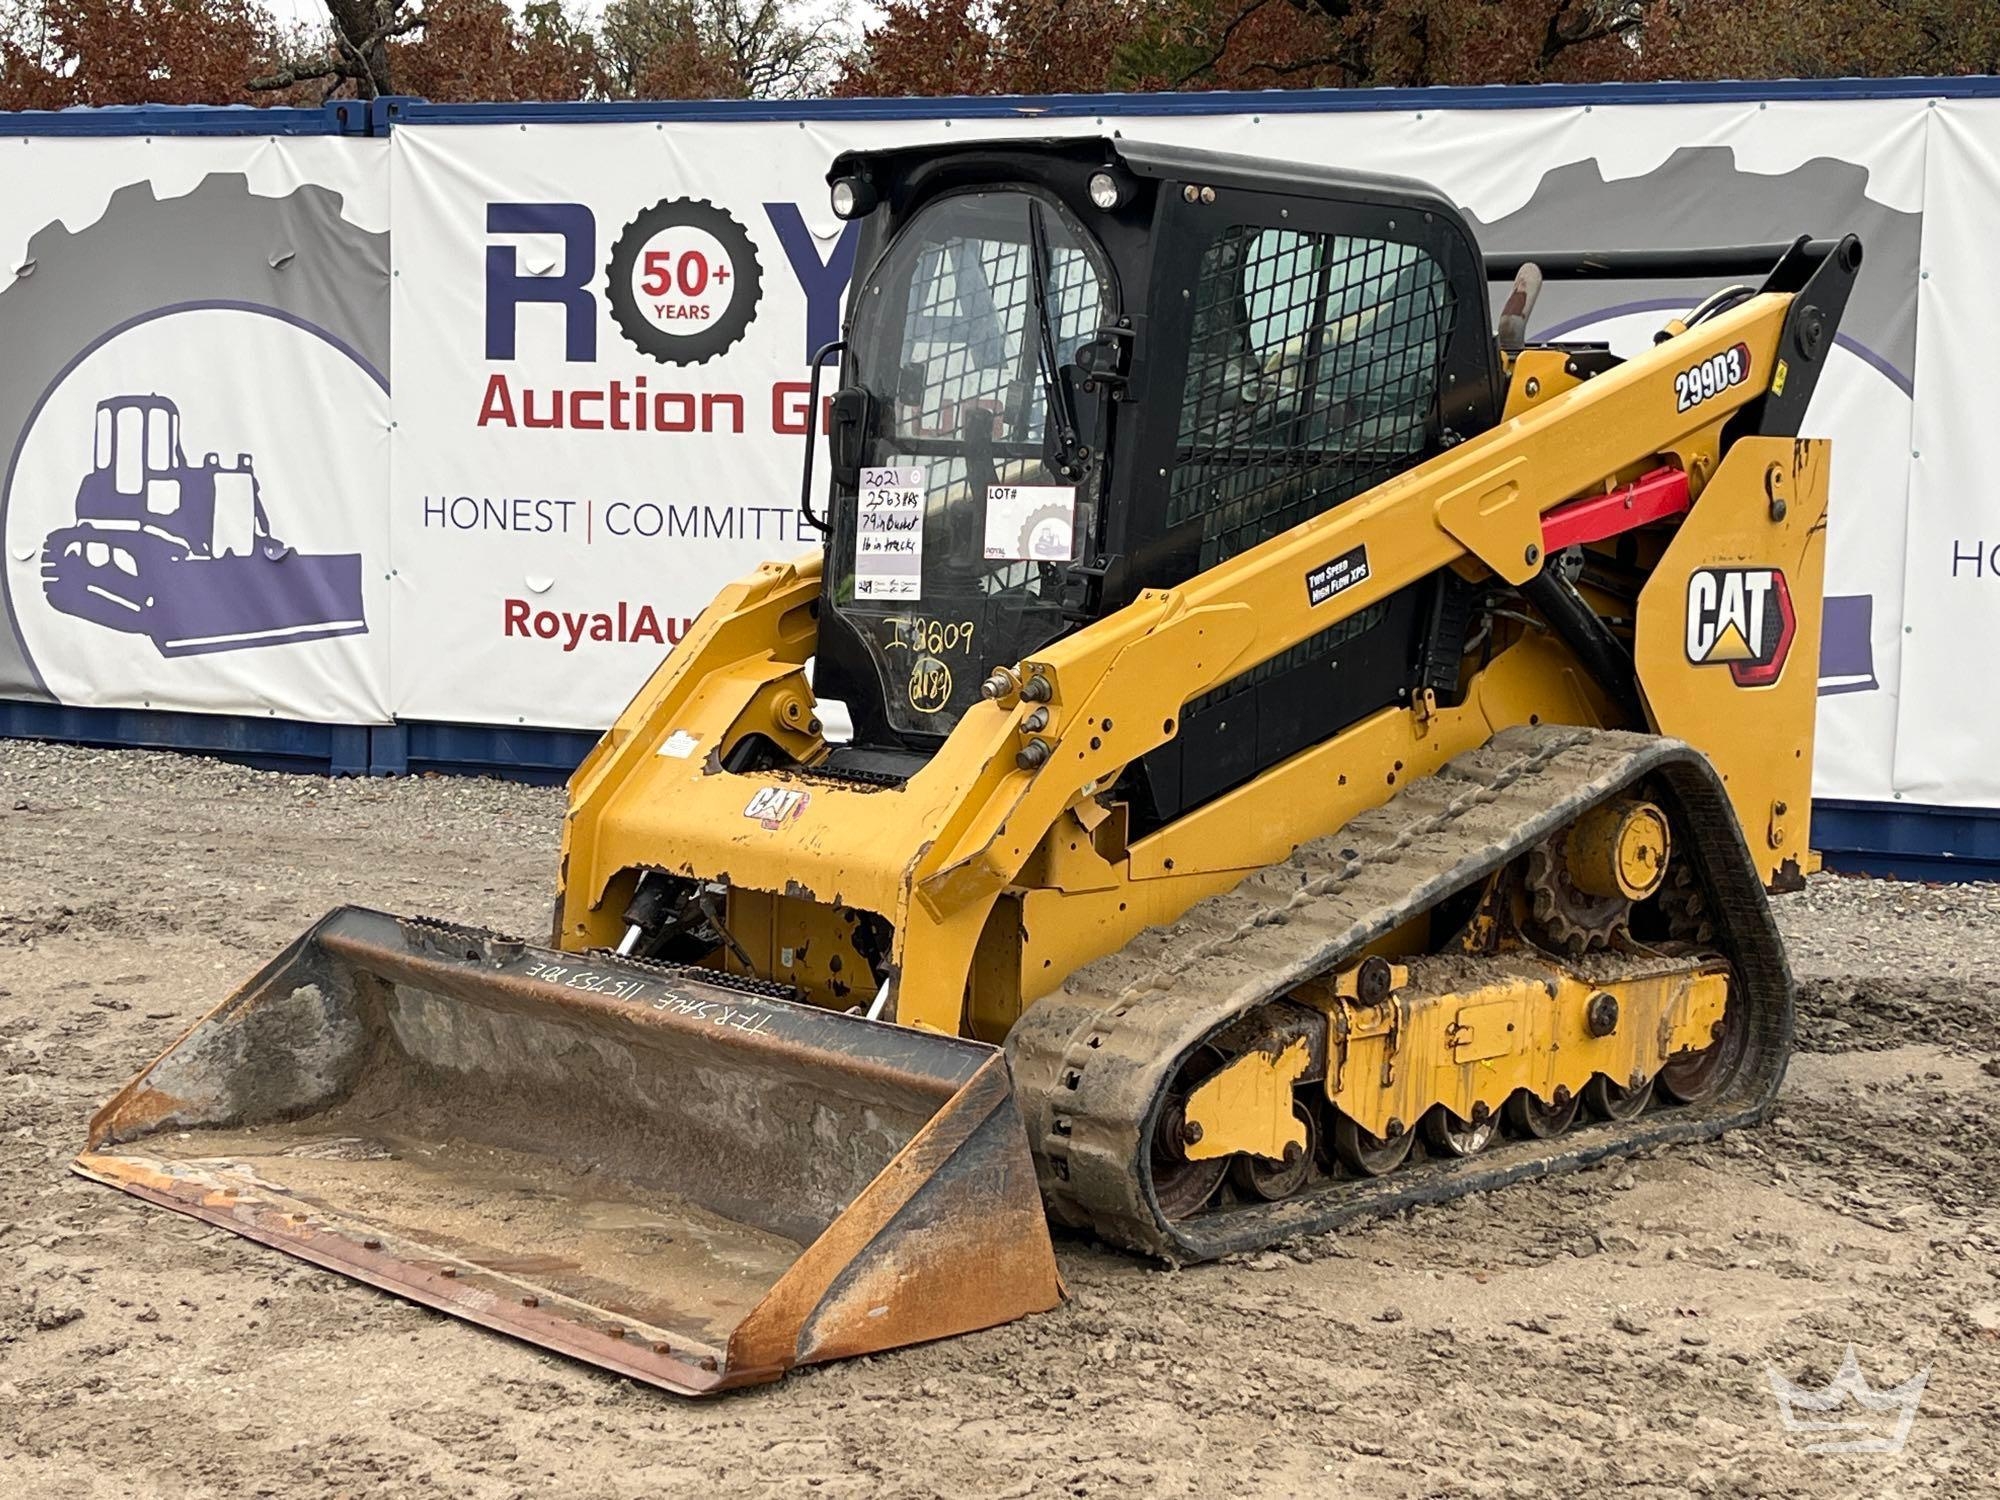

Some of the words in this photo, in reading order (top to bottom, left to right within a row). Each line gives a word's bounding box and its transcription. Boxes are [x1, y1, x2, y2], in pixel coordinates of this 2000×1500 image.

[641, 250, 731, 297] 50+
[654, 304, 711, 320] YEARS
[1675, 348, 1742, 413] 299D3
[477, 374, 744, 434] Auction
[866, 470, 900, 487] 2021
[989, 488, 1017, 499] LOT#
[424, 496, 576, 532] HONEST
[1351, 564, 1366, 581] XPS
[1687, 571, 1773, 662] CAT
[745, 787, 804, 822] CAT
